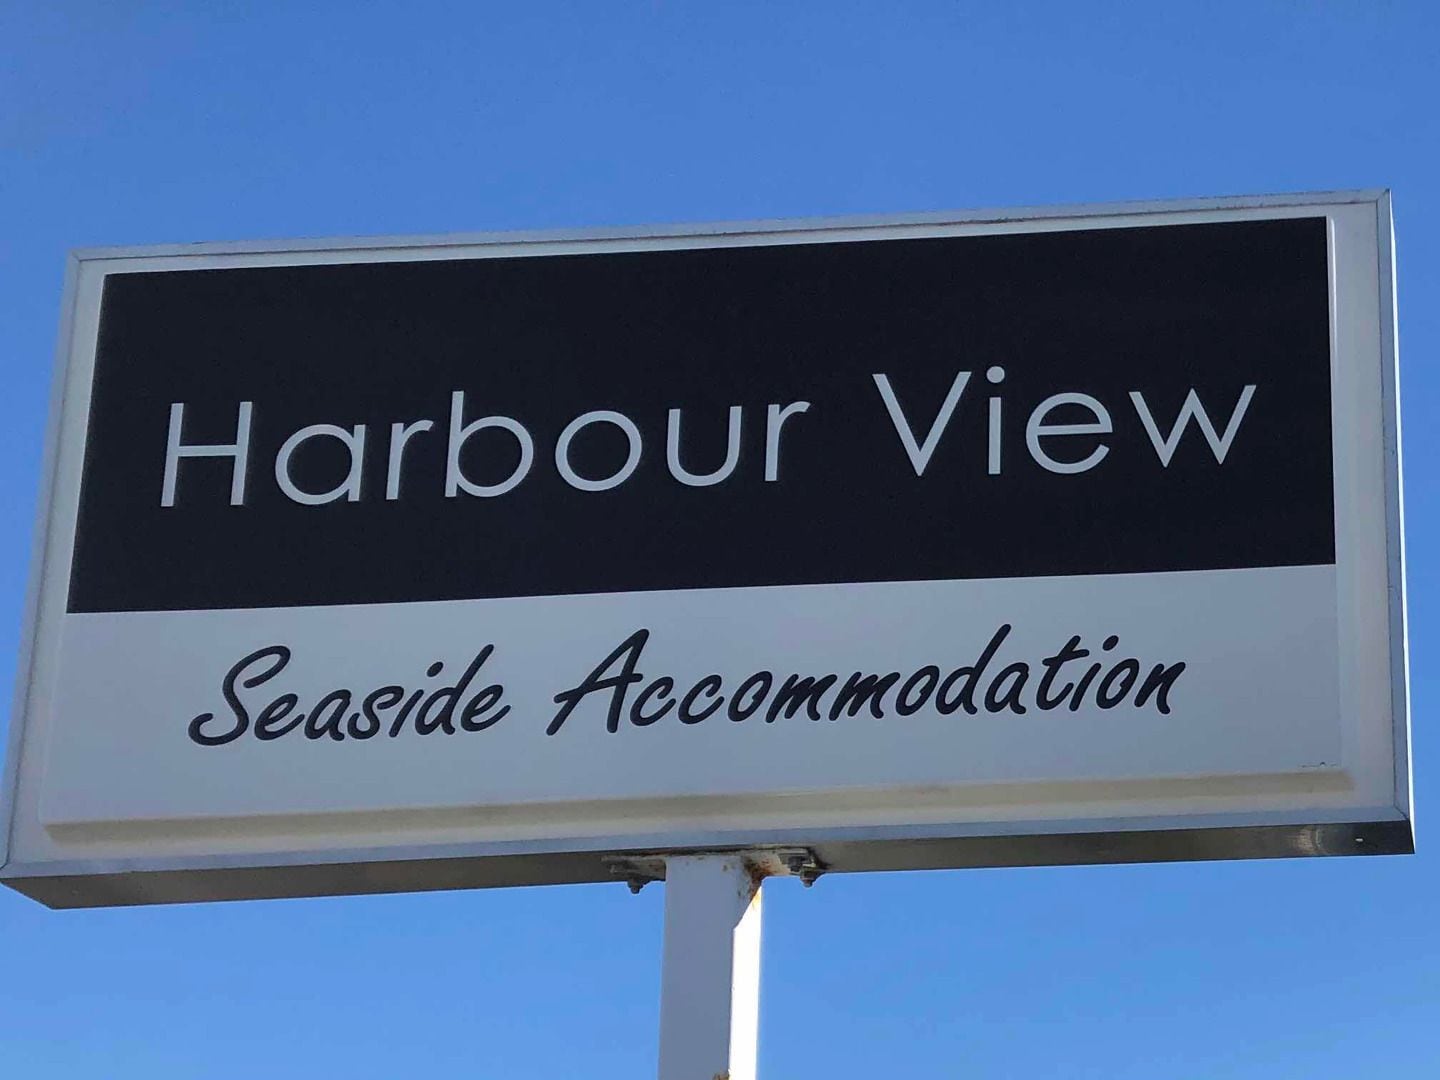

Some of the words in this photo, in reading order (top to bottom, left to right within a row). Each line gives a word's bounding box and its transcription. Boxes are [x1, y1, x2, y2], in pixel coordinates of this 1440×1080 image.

[161, 390, 811, 507] Harbour
[872, 365, 1257, 477] View
[187, 644, 512, 746] Seaside
[546, 623, 1186, 736] Accommodation
